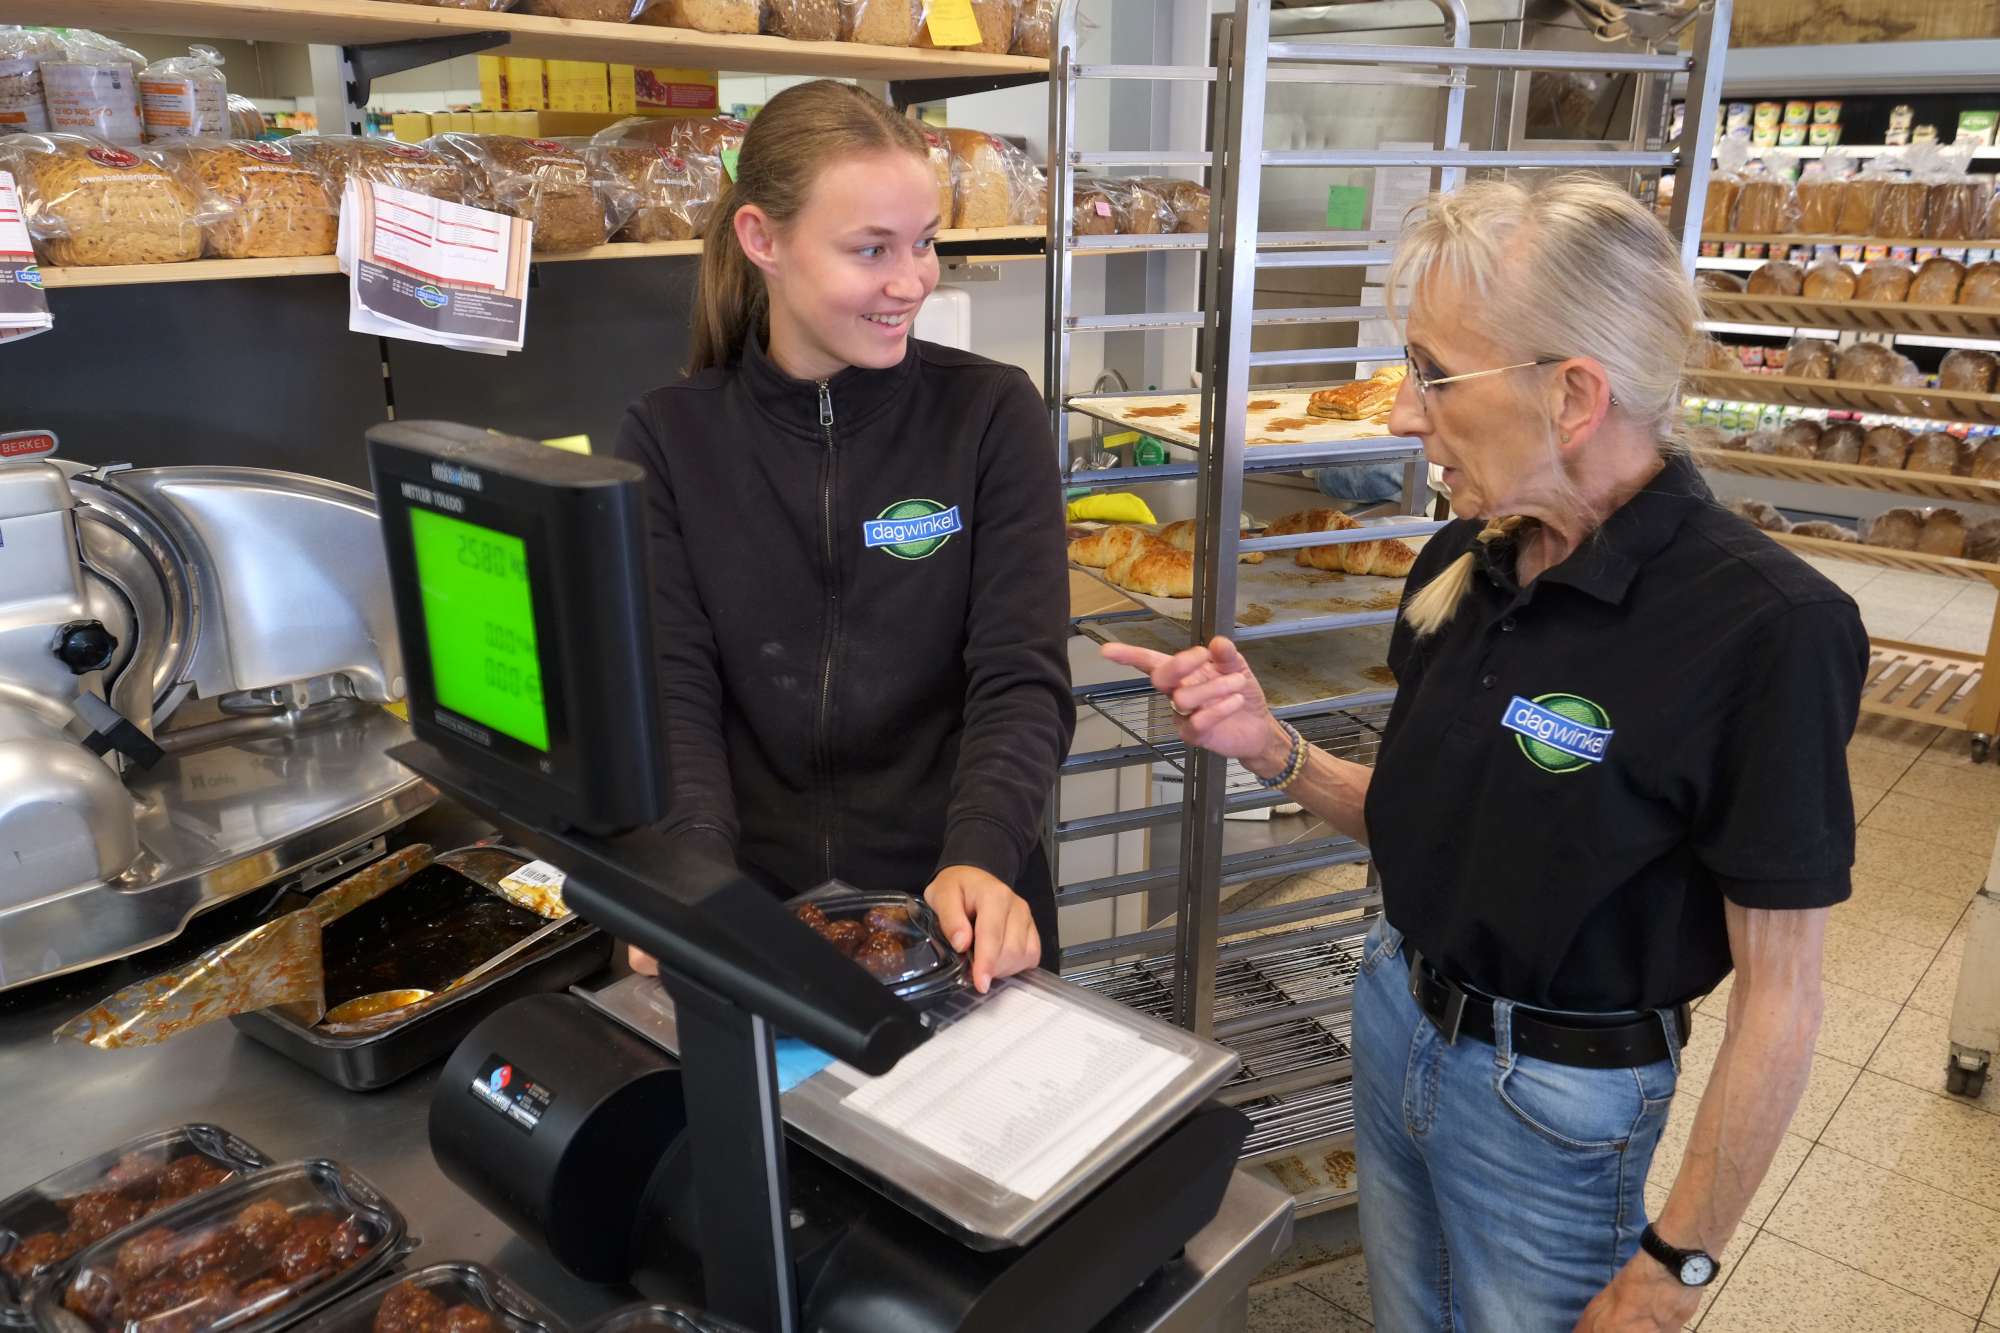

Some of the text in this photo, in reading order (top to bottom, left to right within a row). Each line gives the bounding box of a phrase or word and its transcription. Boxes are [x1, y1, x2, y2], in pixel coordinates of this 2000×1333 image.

[2, 437, 49, 452] BERKEL
[401, 482, 464, 514] METTLER TOLEDO
[872, 511, 955, 541] dagwinkel
[1514, 706, 1609, 754] dagwinkel
